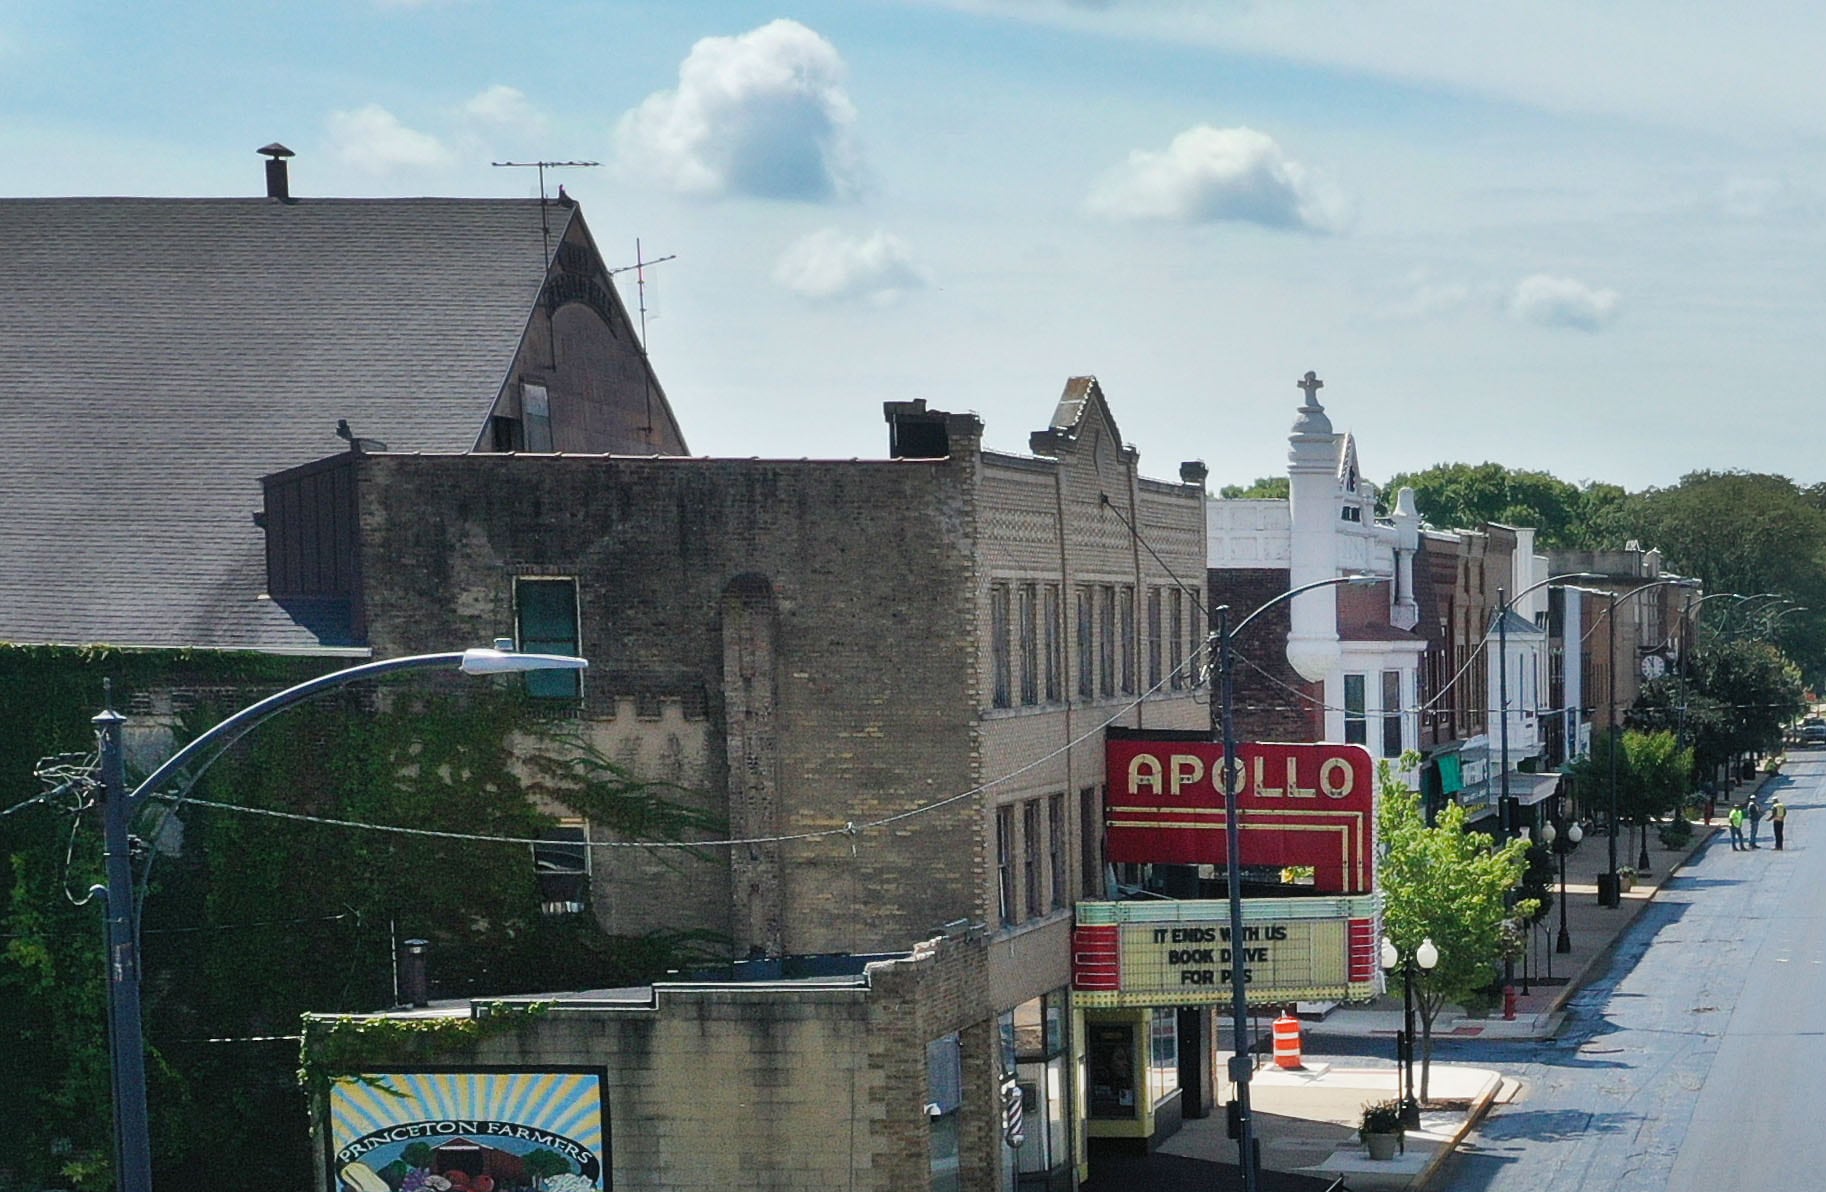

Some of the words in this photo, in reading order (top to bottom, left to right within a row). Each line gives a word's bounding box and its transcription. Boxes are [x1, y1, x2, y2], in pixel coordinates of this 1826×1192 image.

[1128, 754, 1354, 799] APOLLO
[1153, 929, 1169, 944] IT
[1171, 928, 1216, 943] ENDS
[1220, 927, 1260, 942] WTH
[1265, 926, 1287, 941] US
[1168, 949, 1214, 963] BOOK
[1220, 948, 1268, 963] DIVE
[1181, 970, 1214, 985] FOR
[1221, 969, 1252, 984] PS
[340, 1121, 477, 1163] PRINCETON
[487, 1122, 592, 1164] FARMERS
